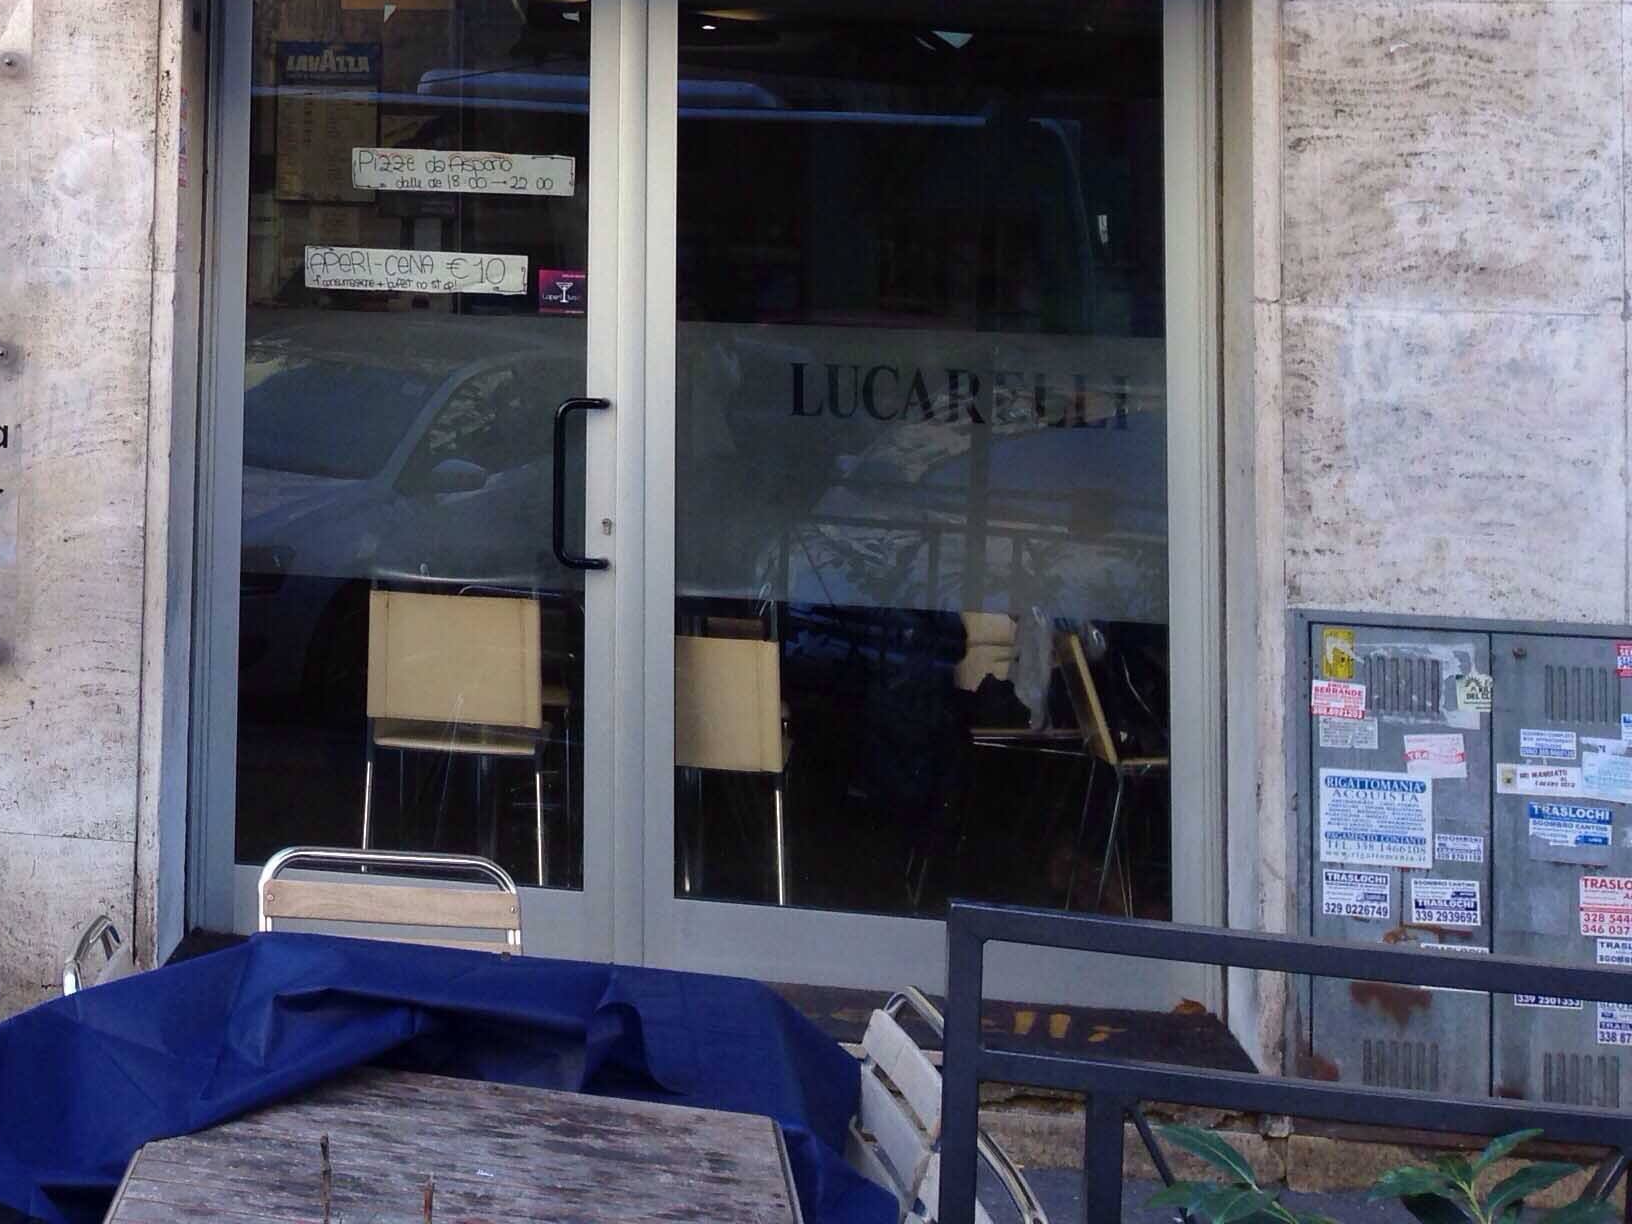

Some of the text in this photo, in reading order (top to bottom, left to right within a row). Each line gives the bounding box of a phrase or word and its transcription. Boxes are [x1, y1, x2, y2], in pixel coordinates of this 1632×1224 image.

[286, 49, 371, 72] LAVAZZA
[789, 362, 1130, 430] LUCARELLI
[1332, 789, 1420, 803] ACQUISTA
[1533, 805, 1610, 821] TRASLOCHI
[1327, 872, 1387, 885] TRASLOCHI
[1325, 902, 1343, 914] 329
[1418, 899, 1475, 910] TRASLOCHI
[1415, 910, 1434, 921] 339
